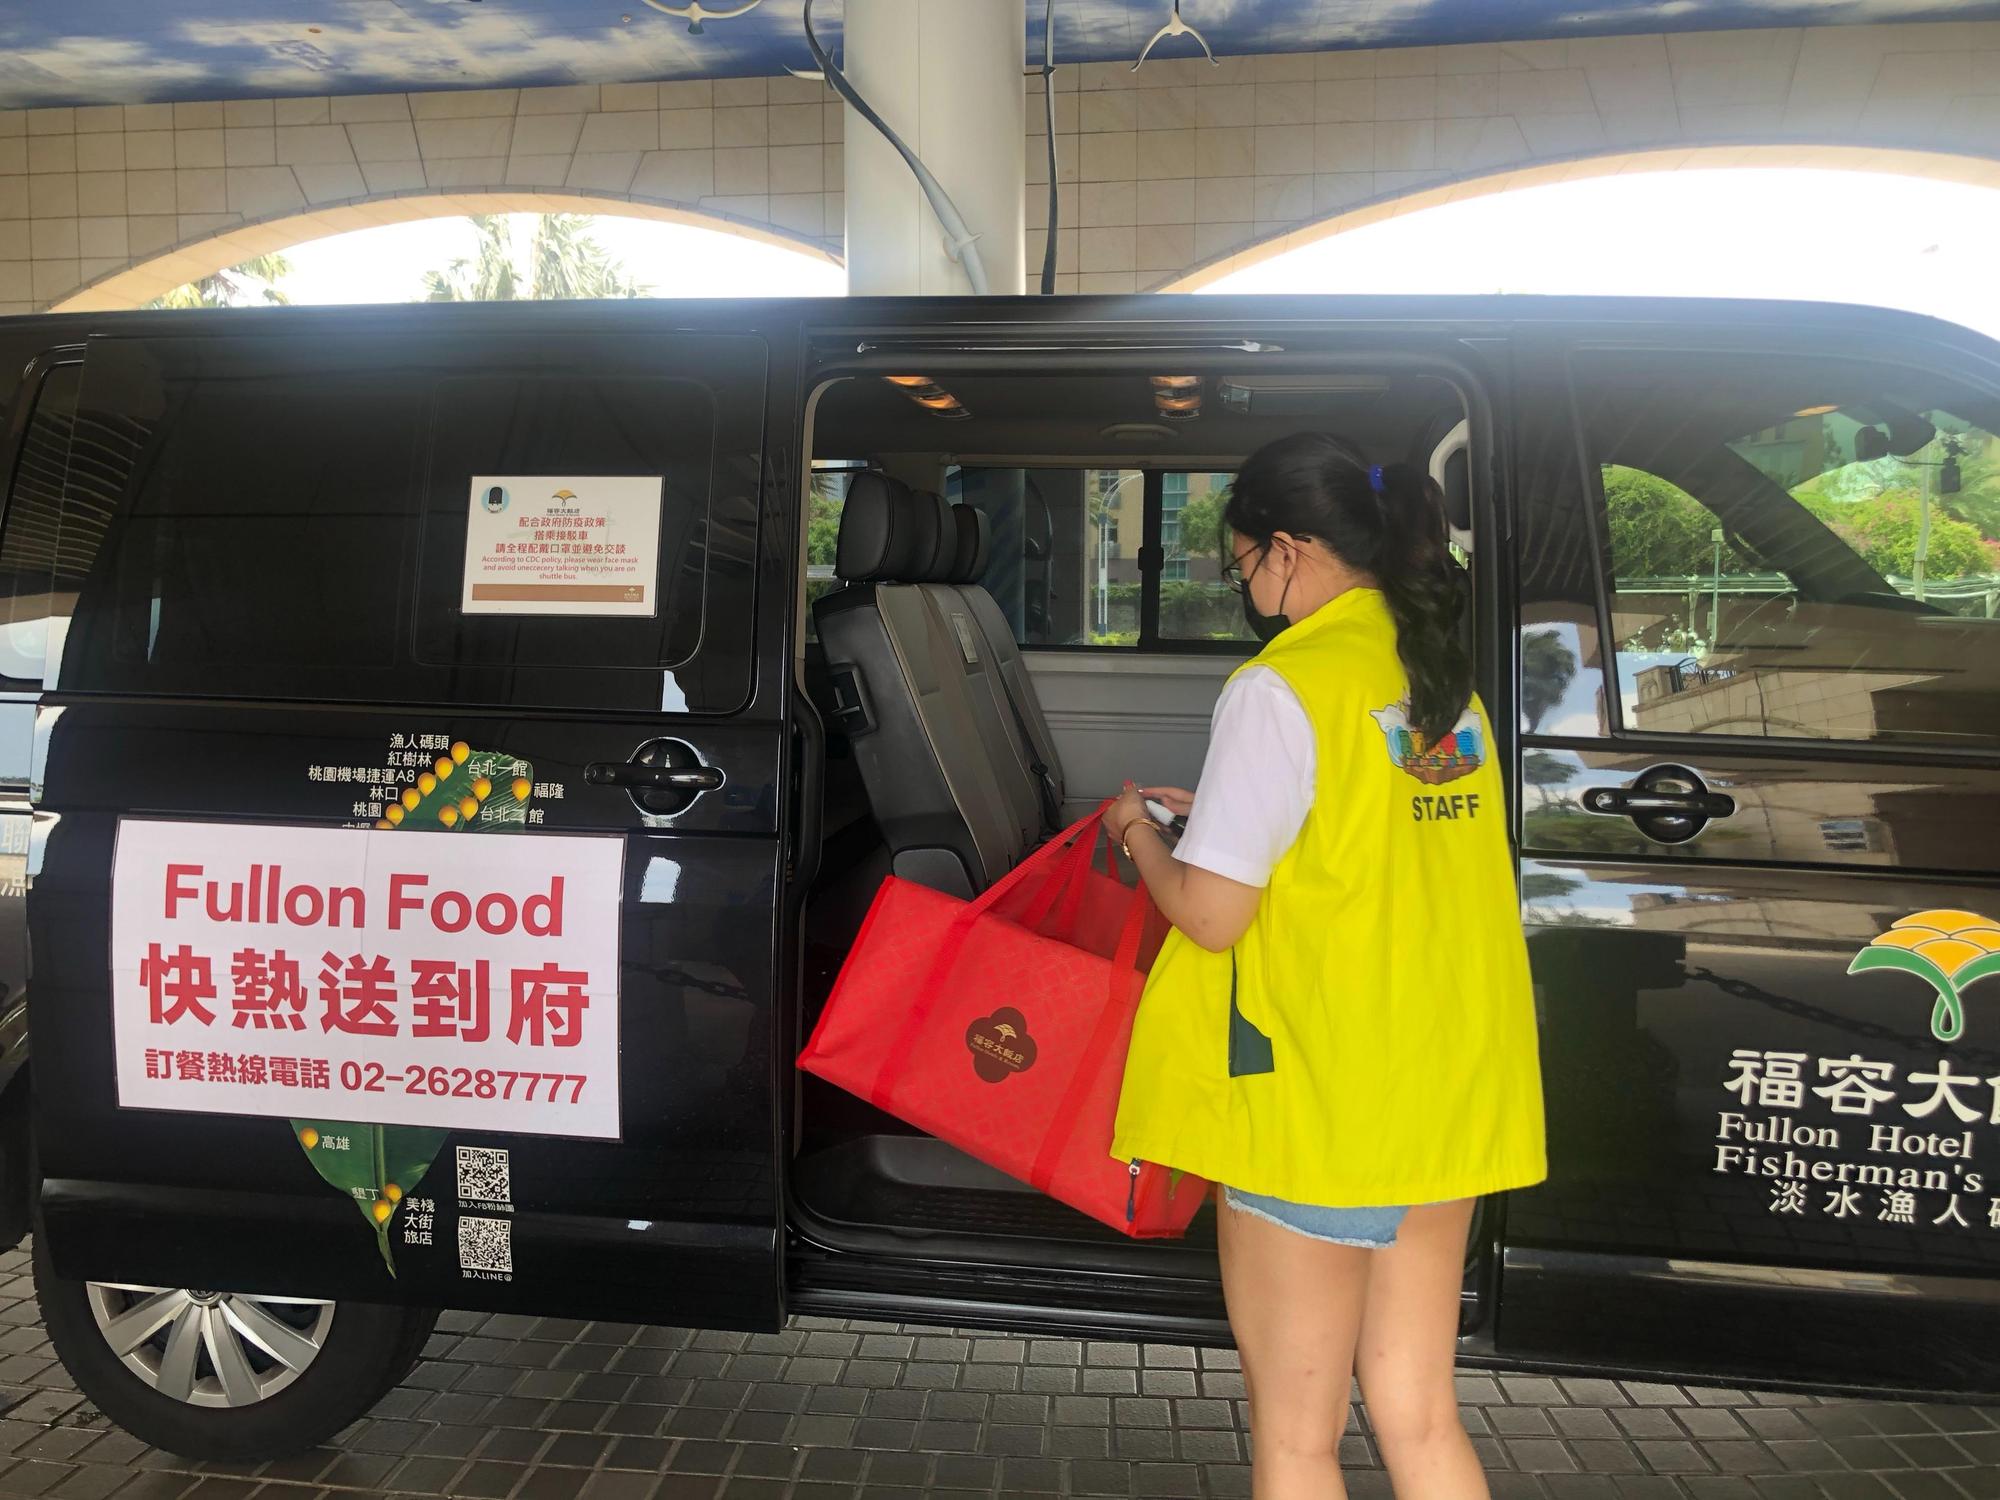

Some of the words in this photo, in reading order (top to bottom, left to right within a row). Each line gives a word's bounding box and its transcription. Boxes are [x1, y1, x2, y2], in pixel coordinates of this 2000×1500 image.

[518, 516, 606, 528] 配合政府防疫政策
[534, 530, 588, 541] 搭乘接駁車
[481, 556, 515, 564] According
[564, 556, 586, 564] please
[605, 556, 619, 564] face
[556, 565, 579, 573] talking
[389, 733, 450, 750] 漁人碼頭
[387, 751, 432, 767] 紅樹林
[467, 758, 527, 777] 台北一館
[308, 765, 415, 784] 桃園機場捷運A8
[369, 785, 399, 801] 林口
[533, 782, 564, 799] 福隆
[352, 801, 382, 818] 桃園
[480, 805, 544, 824] 台北二館
[1412, 794, 1480, 821] STAFF
[164, 863, 366, 928] Fullon
[387, 873, 565, 937] Food
[139, 942, 590, 1048] 快熱送到府
[144, 1048, 330, 1090] 訂餐熱線電話
[339, 1060, 588, 1104] 02-26287777
[1723, 1049, 2000, 1125] 福容大
[321, 1135, 350, 1151] 高雄
[1716, 1112, 1839, 1148] Fullon
[1867, 1124, 1975, 1159] Hotel
[1713, 1145, 1985, 1193] Fisherman's
[351, 1186, 379, 1201] 墾丁
[405, 1197, 435, 1213] 美棧
[404, 1213, 433, 1230] 大街
[404, 1230, 433, 1246] 旅店
[462, 1269, 513, 1282] 加入LINE@
